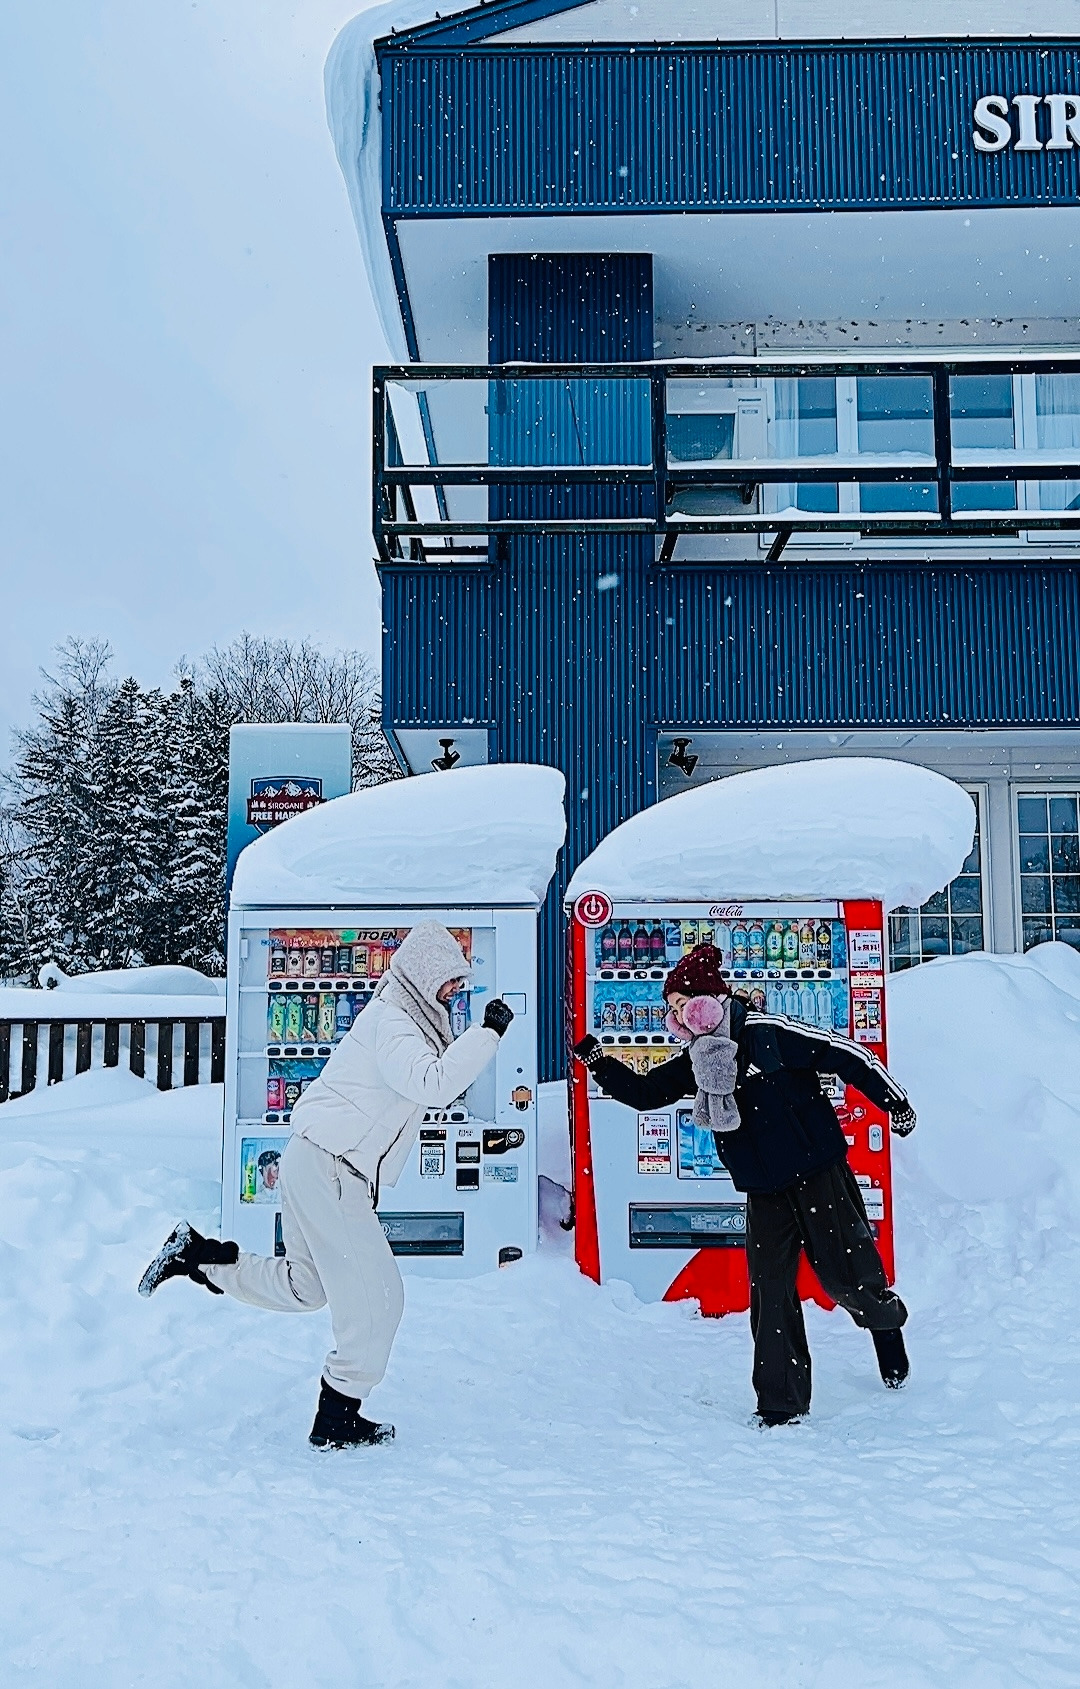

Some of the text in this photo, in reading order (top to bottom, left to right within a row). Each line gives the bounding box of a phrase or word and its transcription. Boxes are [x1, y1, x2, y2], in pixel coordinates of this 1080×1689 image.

[973, 94, 1080, 152] SIR
[267, 802, 304, 810] SIROGANE
[250, 811, 273, 821] FREE
[357, 930, 398, 941] ITO EN
